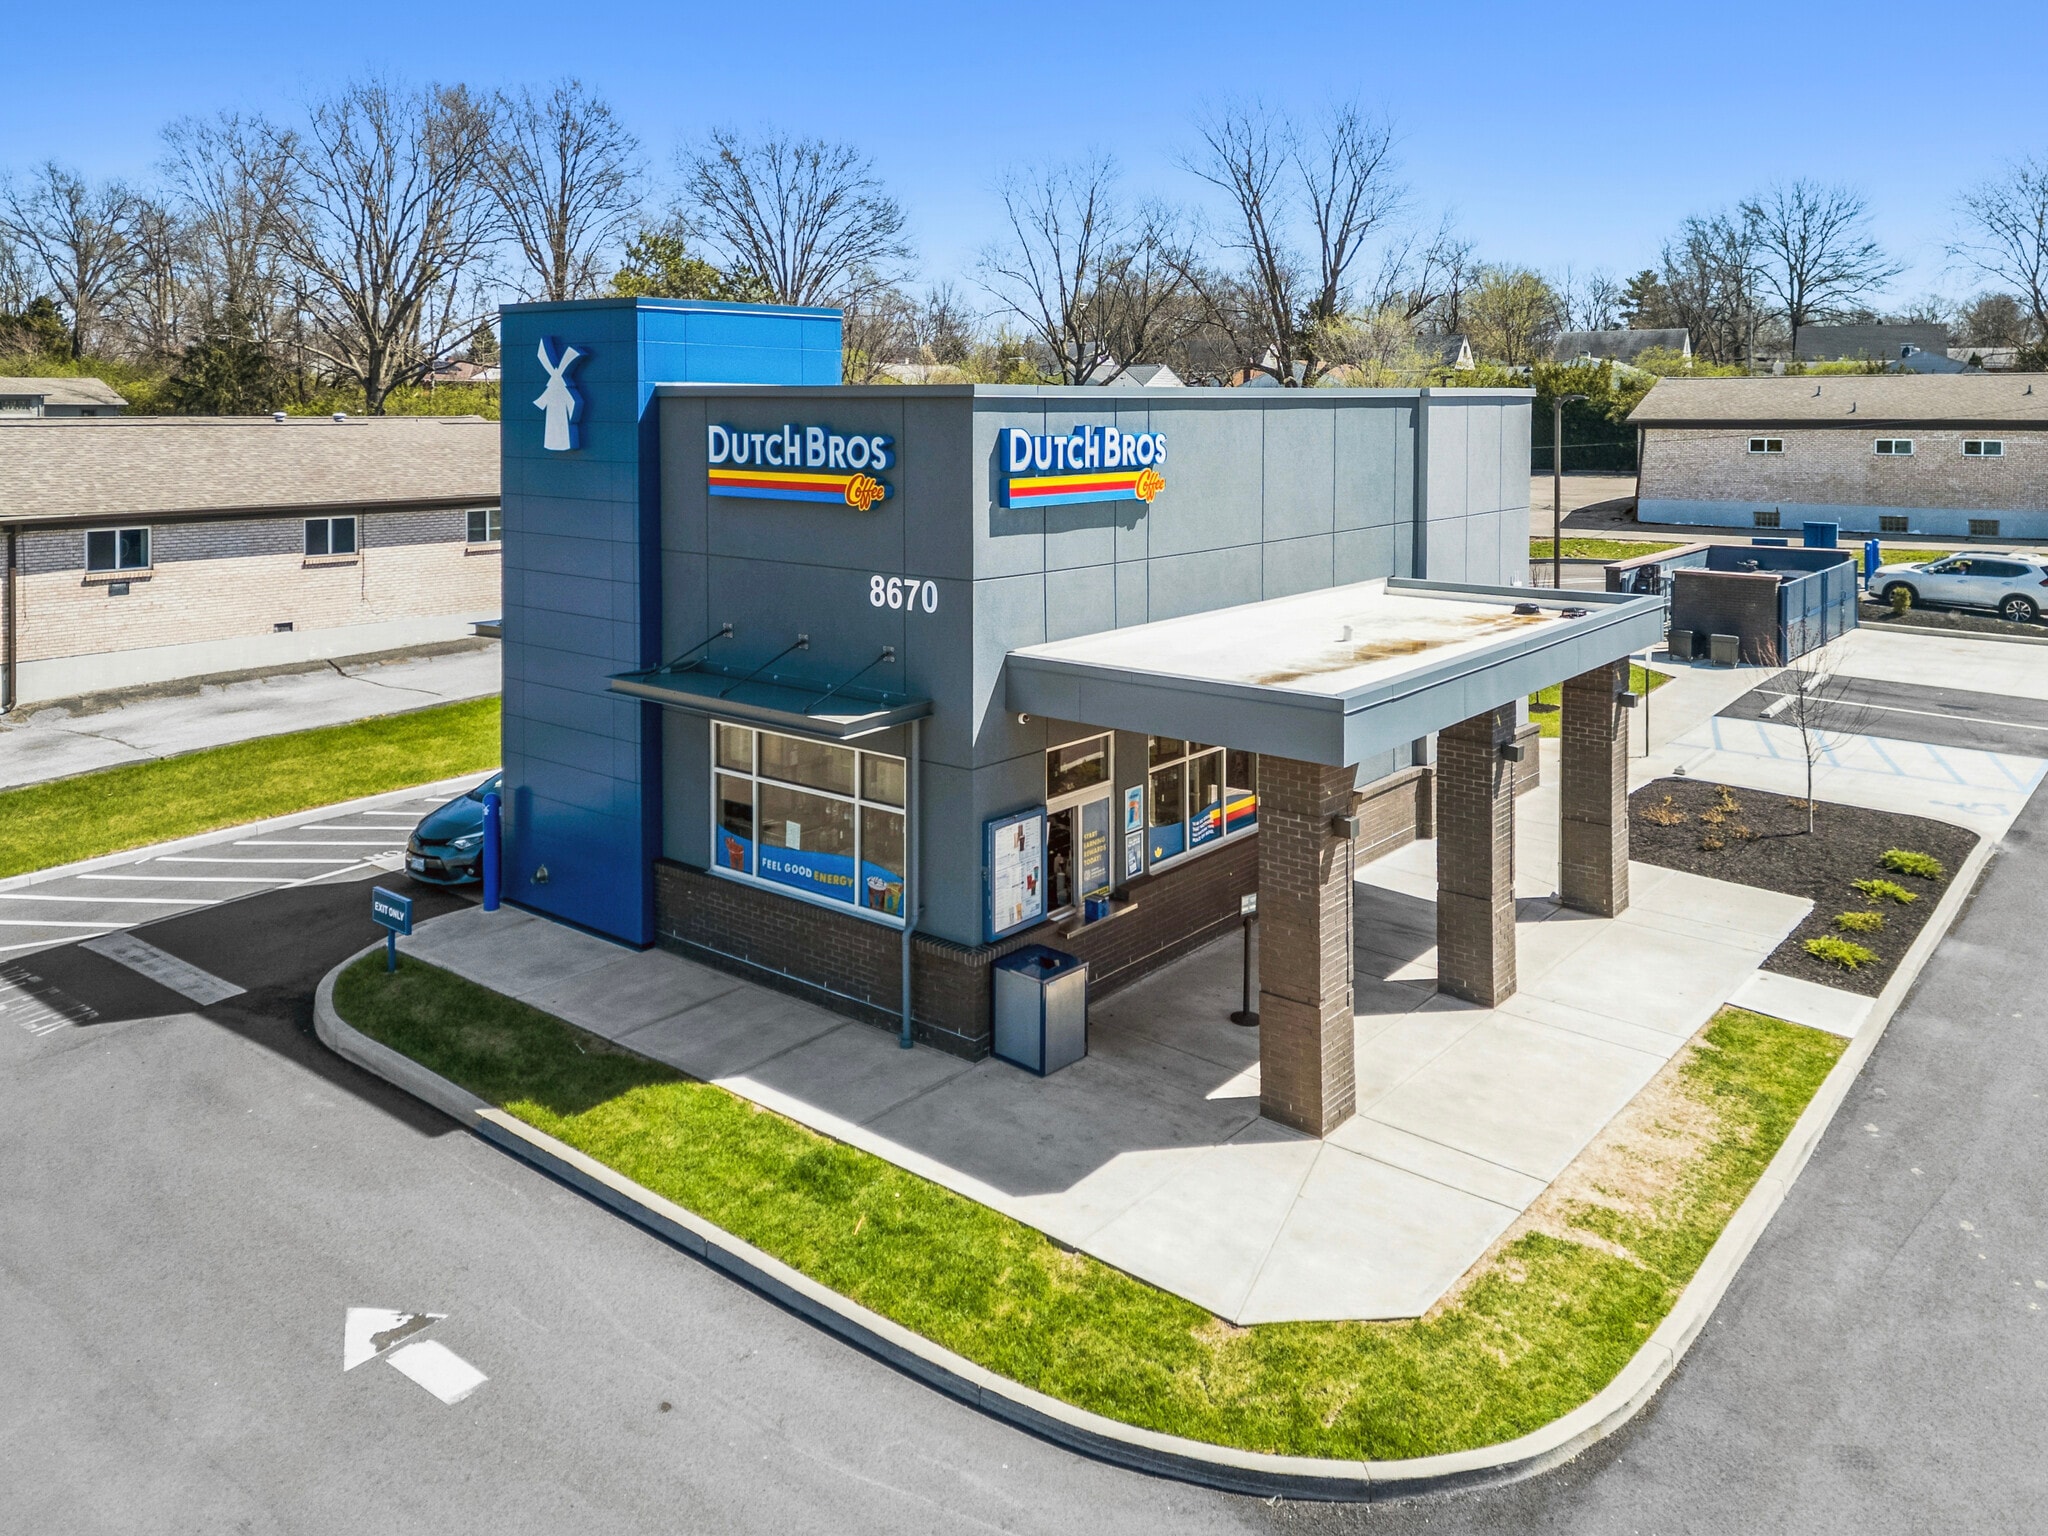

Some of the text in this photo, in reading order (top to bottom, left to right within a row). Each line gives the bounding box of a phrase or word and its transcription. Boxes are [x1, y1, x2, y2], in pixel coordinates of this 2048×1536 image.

[708, 424, 887, 470] DUTCH BROS
[1009, 424, 1168, 473] DUTCH BROS
[846, 474, 885, 511] Coffee
[1136, 468, 1166, 504] Coffee
[869, 574, 938, 614] 8670
[762, 857, 854, 889] FEEL GOOD ENERGY
[374, 901, 405, 921] EXIT ONLY
